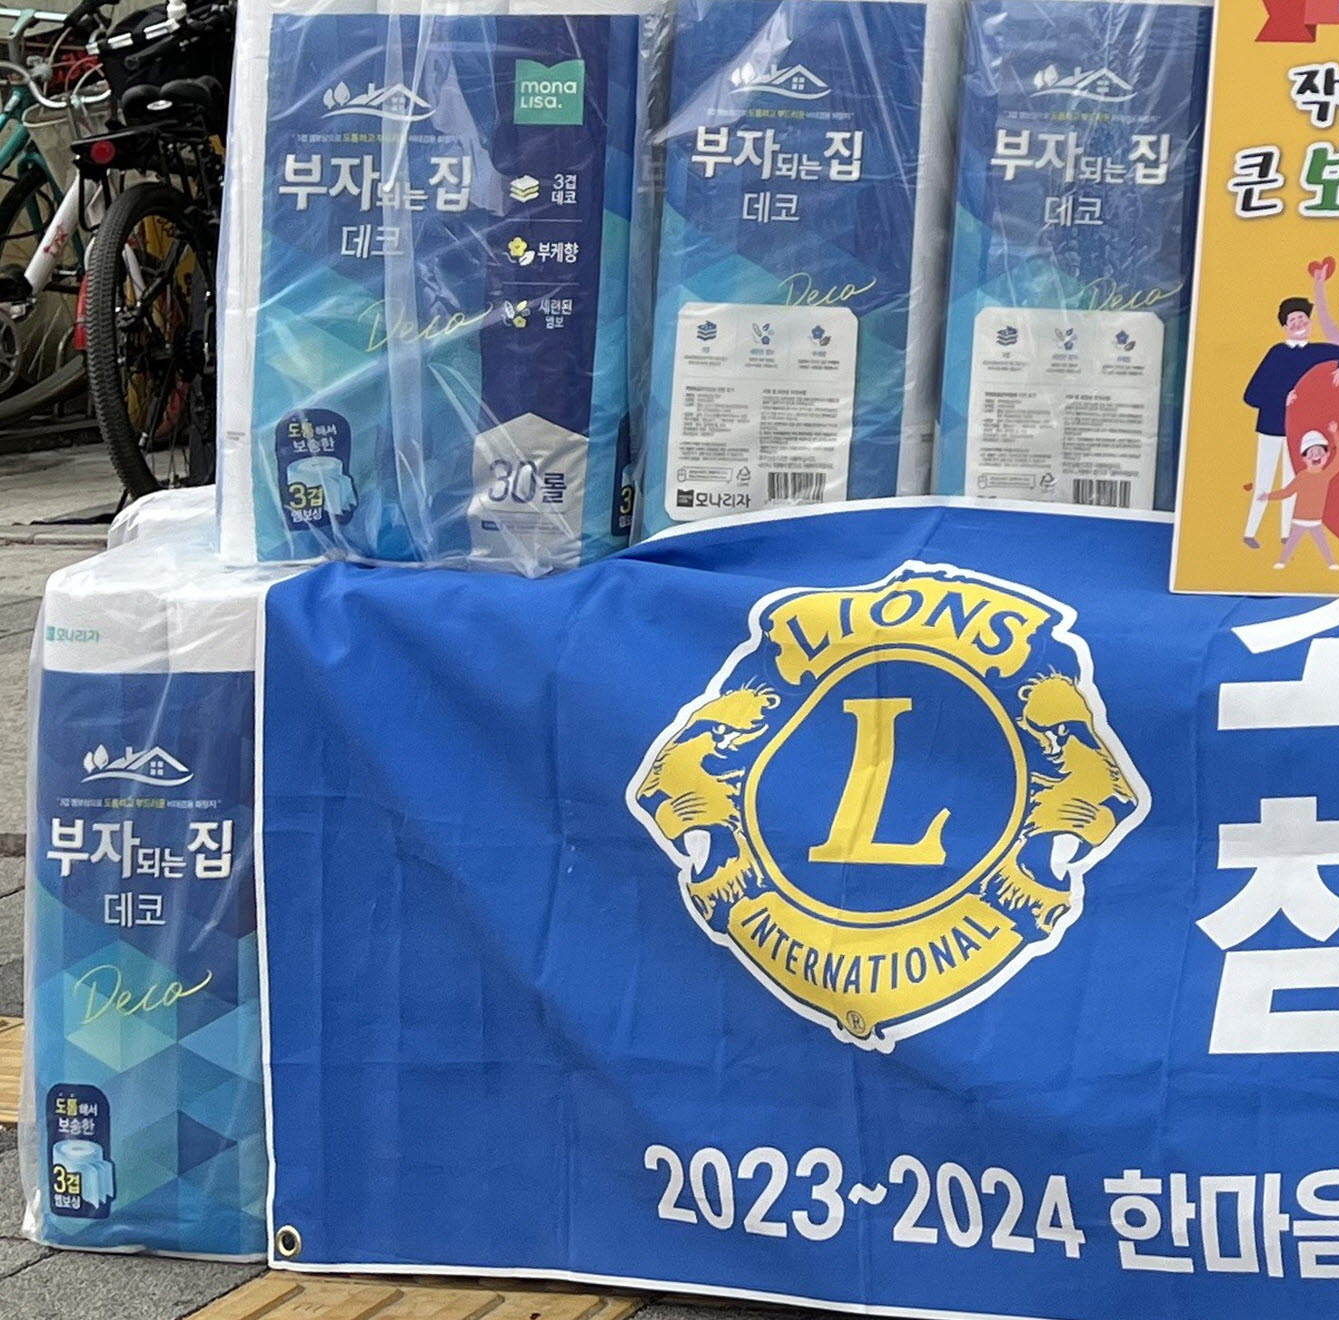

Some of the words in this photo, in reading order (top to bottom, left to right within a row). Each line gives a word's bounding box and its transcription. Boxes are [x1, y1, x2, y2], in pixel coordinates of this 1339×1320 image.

[520, 80, 578, 94] mona
[691, 125, 864, 182] 부자되는집
[989, 128, 1172, 186] 부자되는집
[550, 190, 578, 205] 데코
[553, 173, 578, 190] 3겹
[1230, 148, 1284, 216] 큰
[742, 191, 801, 223] 데코
[1043, 195, 1104, 228] 데코
[341, 224, 404, 259] 데코
[537, 241, 579, 264] 부케향
[777, 271, 878, 307] Deco
[487, 458, 568, 505] 30롤
[695, 491, 752, 509] 모나리자
[56, 627, 100, 643] 모나리자
[786, 588, 1029, 663] LIONS
[807, 696, 953, 867] L
[45, 815, 235, 880] 부자되는집
[103, 890, 167, 929] 데코
[741, 901, 1001, 996] INTERNATIONAL
[72, 963, 213, 1025] Deco
[57, 1118, 96, 1137] 보송한
[52, 1162, 82, 1195] 3겹
[643, 1143, 1087, 1260] 2023~2024
